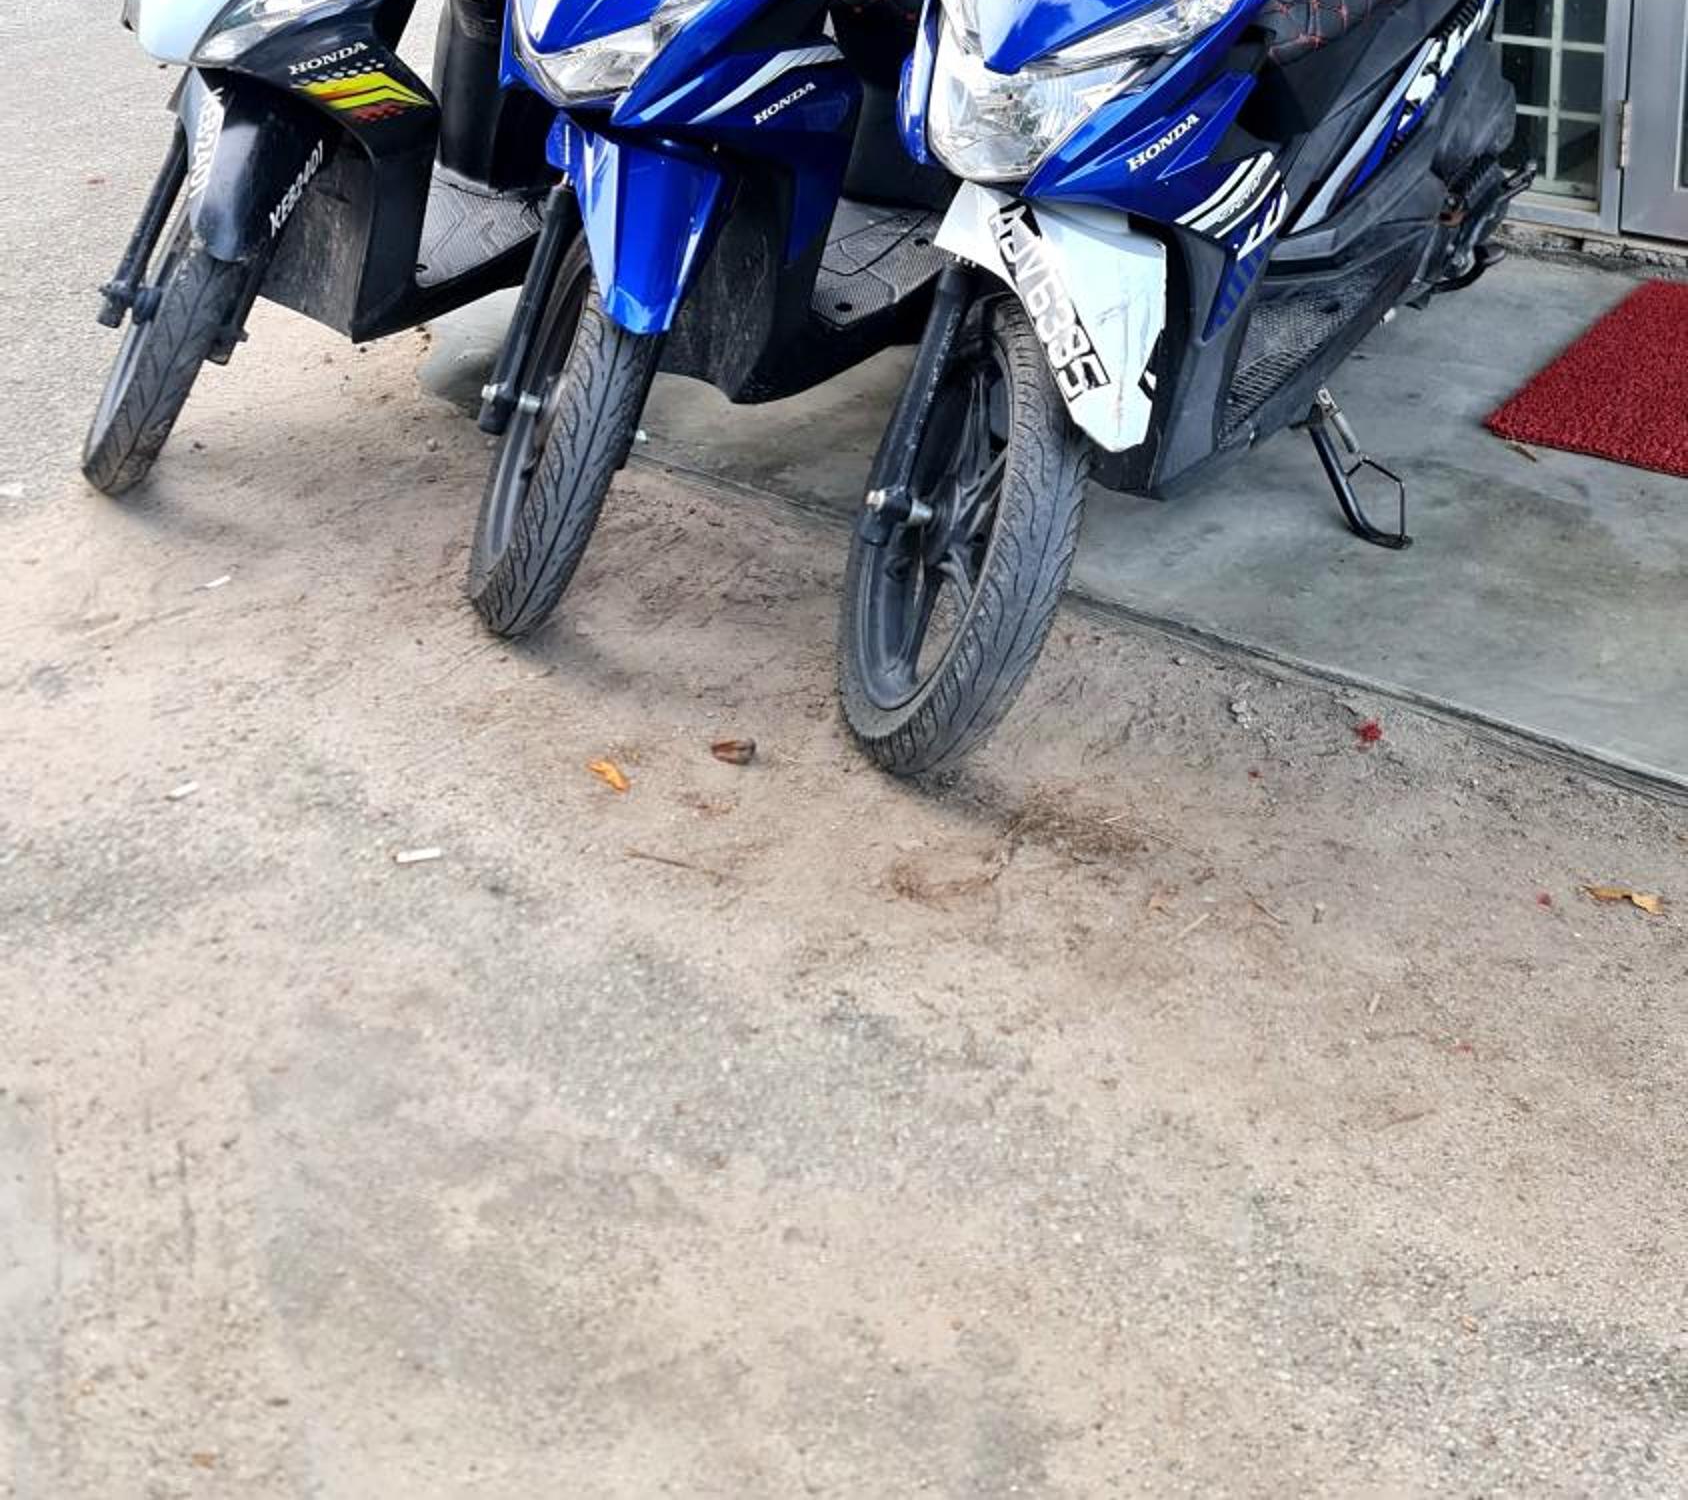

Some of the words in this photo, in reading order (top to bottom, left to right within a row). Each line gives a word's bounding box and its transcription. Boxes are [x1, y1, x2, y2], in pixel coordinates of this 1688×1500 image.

[288, 42, 369, 76] HONDA
[753, 81, 817, 125] HONDA
[1127, 113, 1200, 171] HONDA
